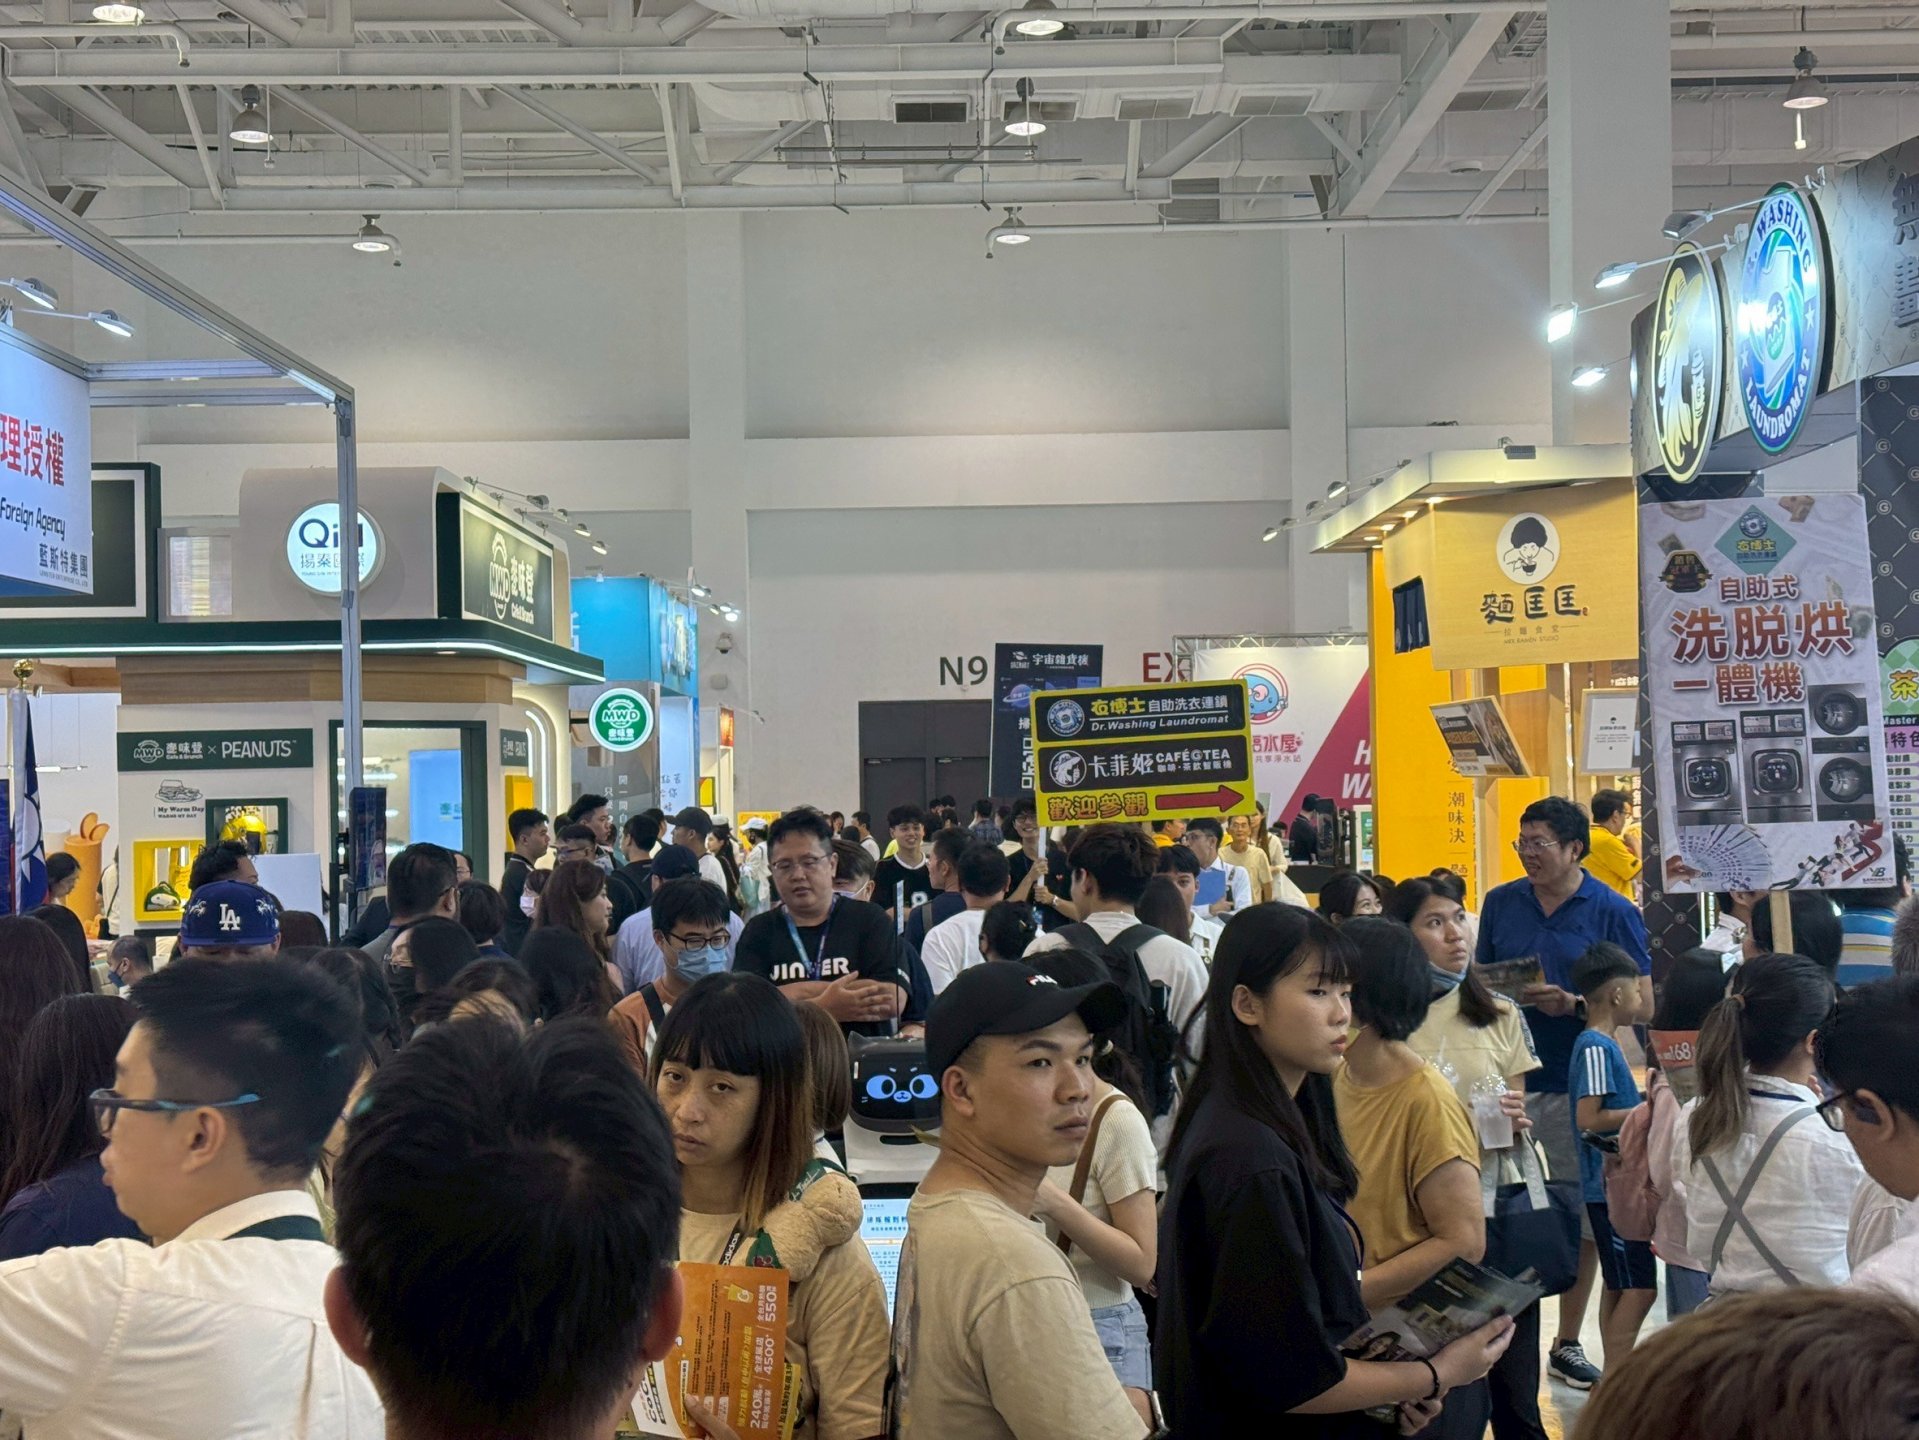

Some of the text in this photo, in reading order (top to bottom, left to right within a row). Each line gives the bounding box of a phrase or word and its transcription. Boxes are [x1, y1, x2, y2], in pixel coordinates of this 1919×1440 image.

[1756, 199, 1811, 273] WASHING
[1746, 348, 1810, 438] LAUNDROMAT
[0, 413, 65, 487] 理授權
[0, 497, 66, 541] Foreign Agency
[1720, 575, 1798, 600] 自助式
[1480, 585, 1581, 624] 麵匡匡
[1669, 601, 1854, 662] 洗脫烘
[940, 655, 988, 686] N9
[1672, 664, 1805, 705] 一體機
[602, 709, 640, 723] MWD
[1148, 695, 1228, 713] 自助洗衣連鎖
[1159, 714, 1229, 728] Laundromat
[134, 747, 164, 759] MWD
[222, 740, 292, 759] PEANUTS
[192, 806, 204, 814] Day
[1048, 792, 1148, 821] 歡迎參觀
[219, 903, 241, 931] LA
[769, 956, 850, 981] JINER
